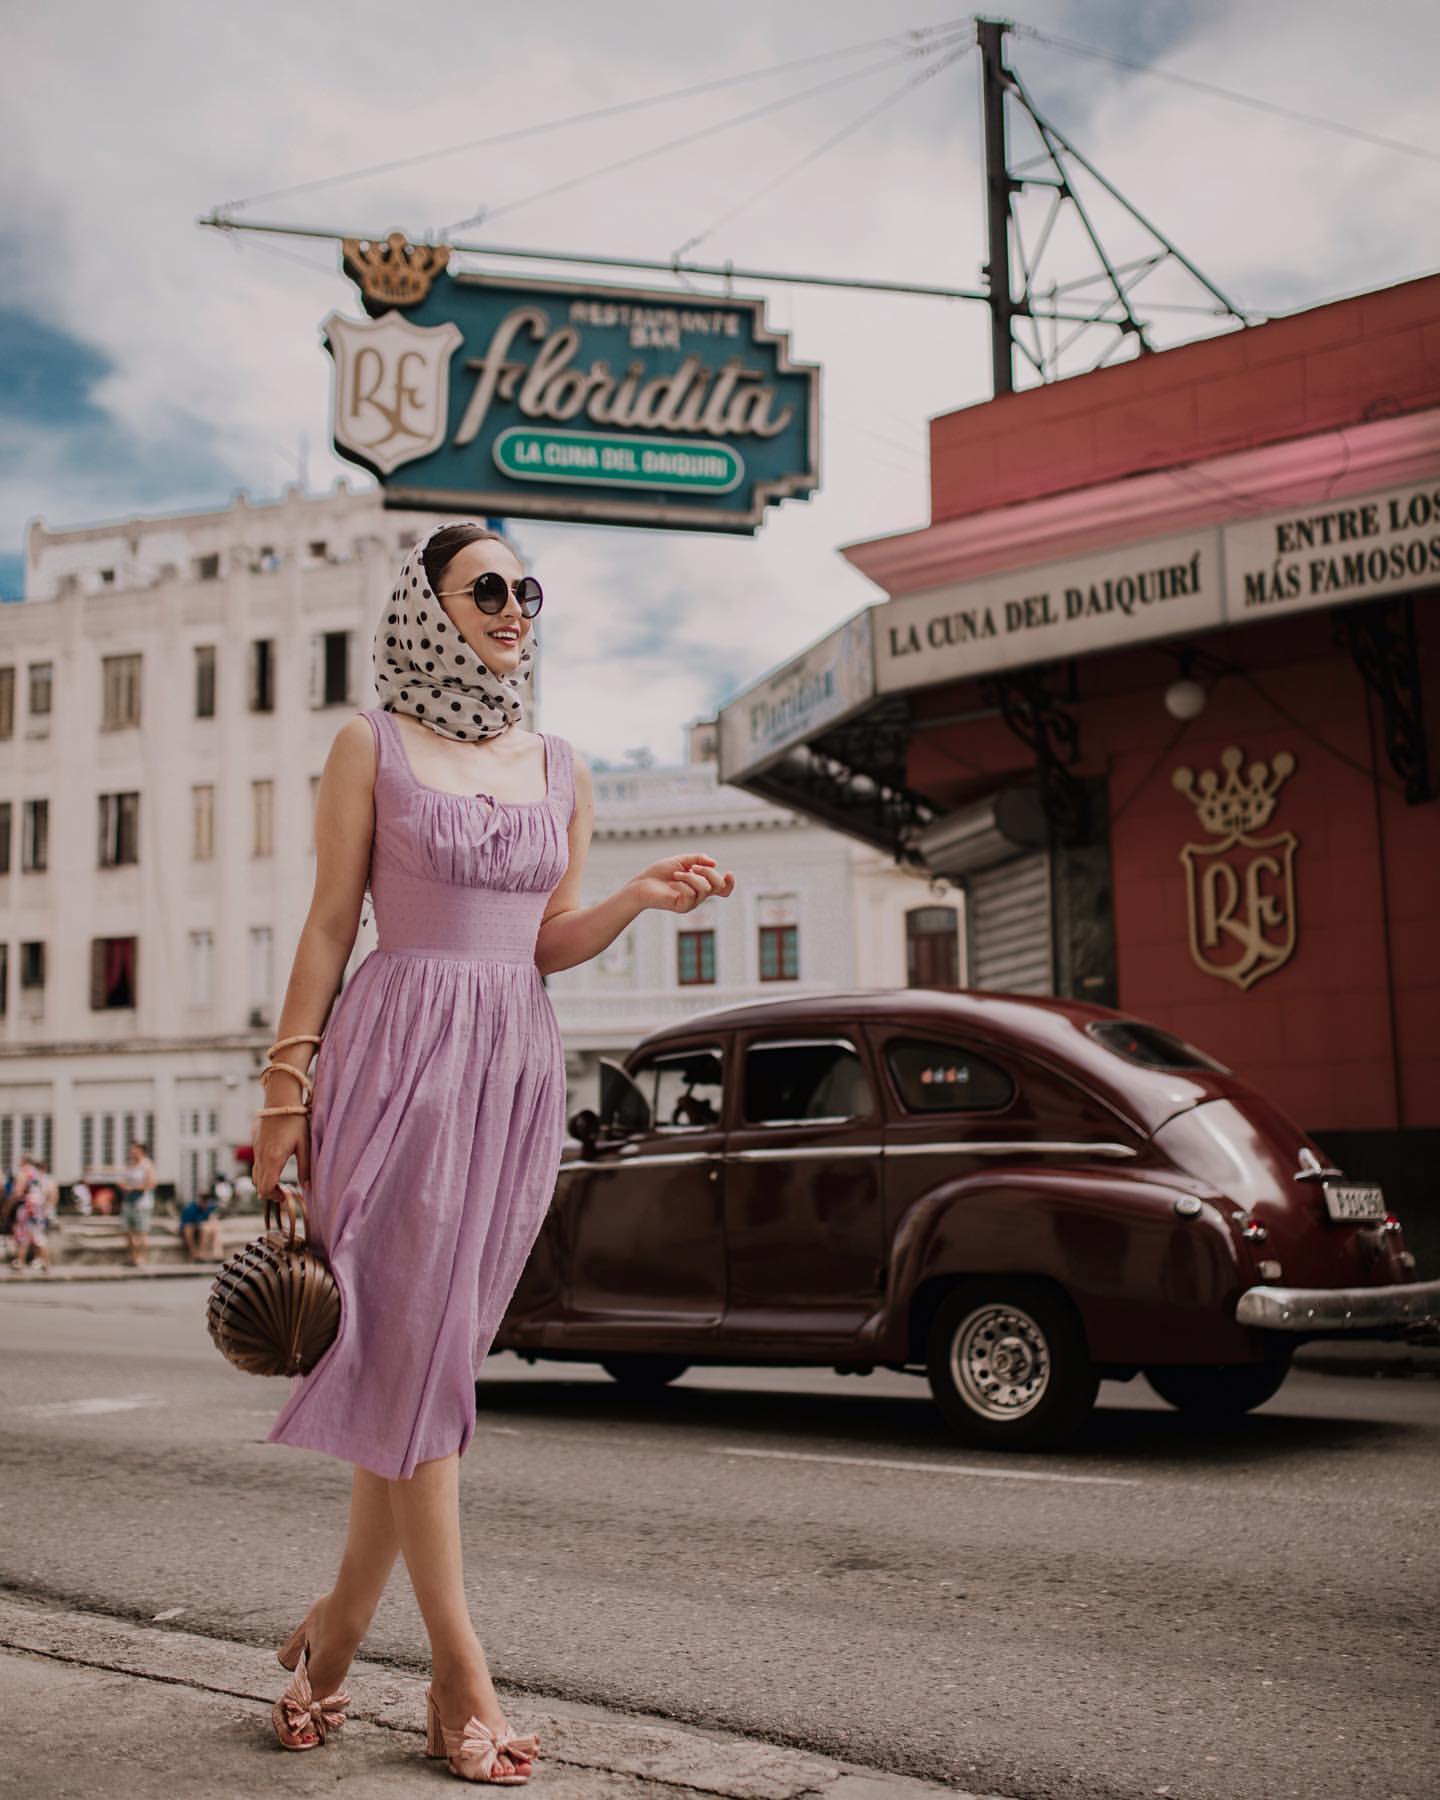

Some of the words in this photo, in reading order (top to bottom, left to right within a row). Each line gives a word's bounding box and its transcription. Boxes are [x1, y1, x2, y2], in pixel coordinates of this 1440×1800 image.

[629, 325, 680, 350] BAR
[514, 441, 541, 464] LA
[543, 443, 599, 468] CUNA
[601, 447, 638, 472] DEL
[1276, 503, 1380, 555] ENTRE
[1243, 556, 1301, 608] MÁS
[1308, 535, 1440, 595] FAMOSOS
[889, 625, 923, 657] LA
[926, 608, 998, 650] CUNA
[1005, 594, 1060, 634] DEL
[1064, 550, 1202, 617] DAIQUIRÍ
